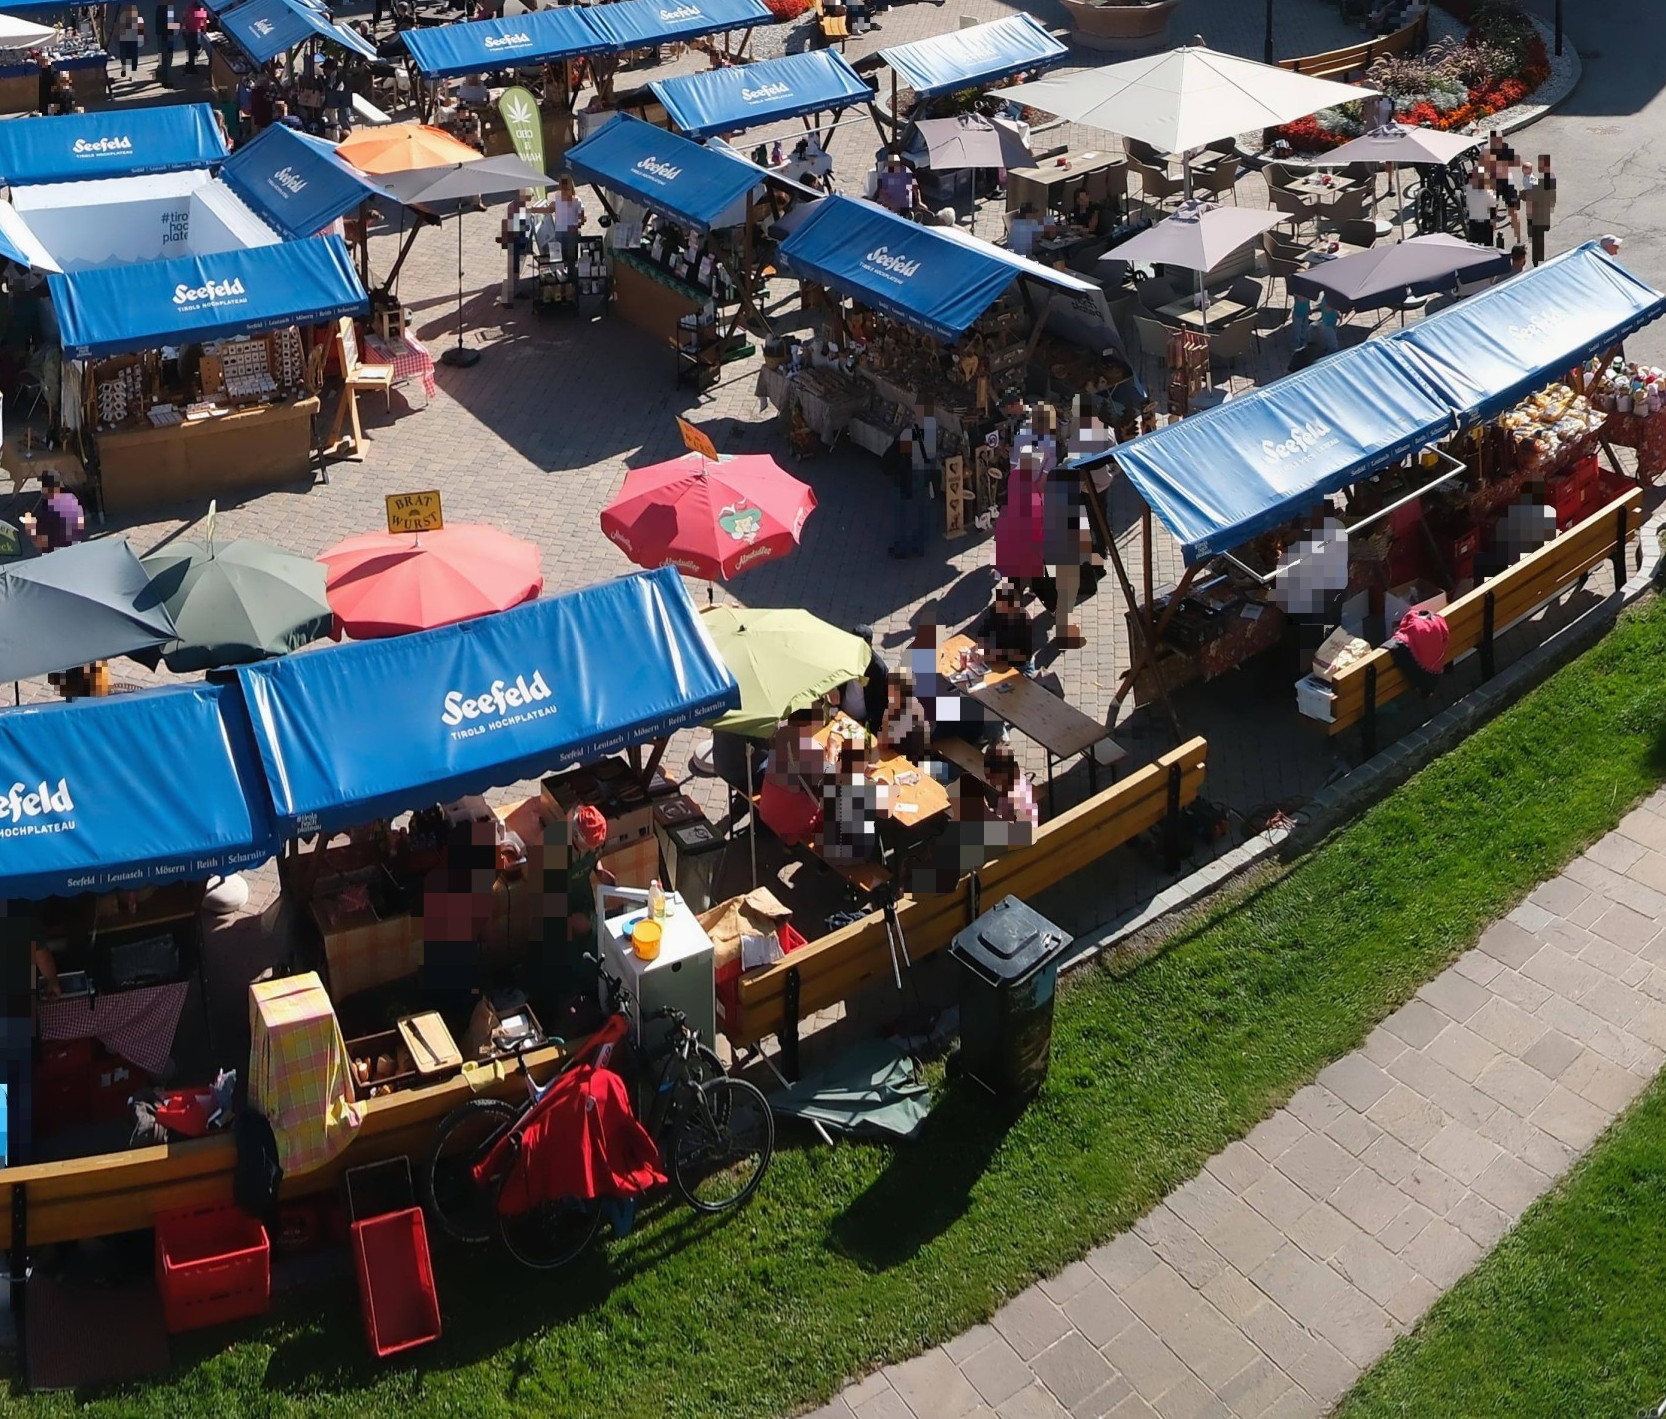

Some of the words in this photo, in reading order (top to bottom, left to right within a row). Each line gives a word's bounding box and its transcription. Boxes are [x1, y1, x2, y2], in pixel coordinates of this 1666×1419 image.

[659, 5, 702, 21] Seefeld
[484, 32, 531, 48] Seefeld
[740, 83, 790, 102] Seefeld
[73, 135, 133, 154] Seefeld
[273, 166, 308, 194] Seefeld
[636, 157, 684, 181] Seefeld
[162, 211, 190, 224] #tiro
[866, 246, 921, 278] Seefeld
[172, 277, 245, 305] Seefeld
[177, 302, 200, 313] TIROLS
[202, 297, 248, 309] HOCHPLATEAU
[1261, 418, 1331, 460] Seefeld
[394, 495, 433, 511] BRAT
[392, 512, 438, 530] WURST
[735, 547, 772, 570] Almdudler
[441, 670, 553, 726] Seefeld
[450, 724, 487, 742] TIROLS
[488, 706, 558, 732] HOCHPLATEAU
[559, 746, 585, 762] Seefeld
[592, 735, 625, 752] Leutasch
[633, 724, 660, 740] Mösern
[668, 713, 687, 727] Reith
[694, 700, 727, 718] Scharnitz
[67, 876, 95, 888] Seefeld
[108, 868, 144, 883] Leutasch
[156, 863, 186, 876] Mösern
[197, 857, 219, 870] Reith
[228, 849, 268, 865] Scharnitz
